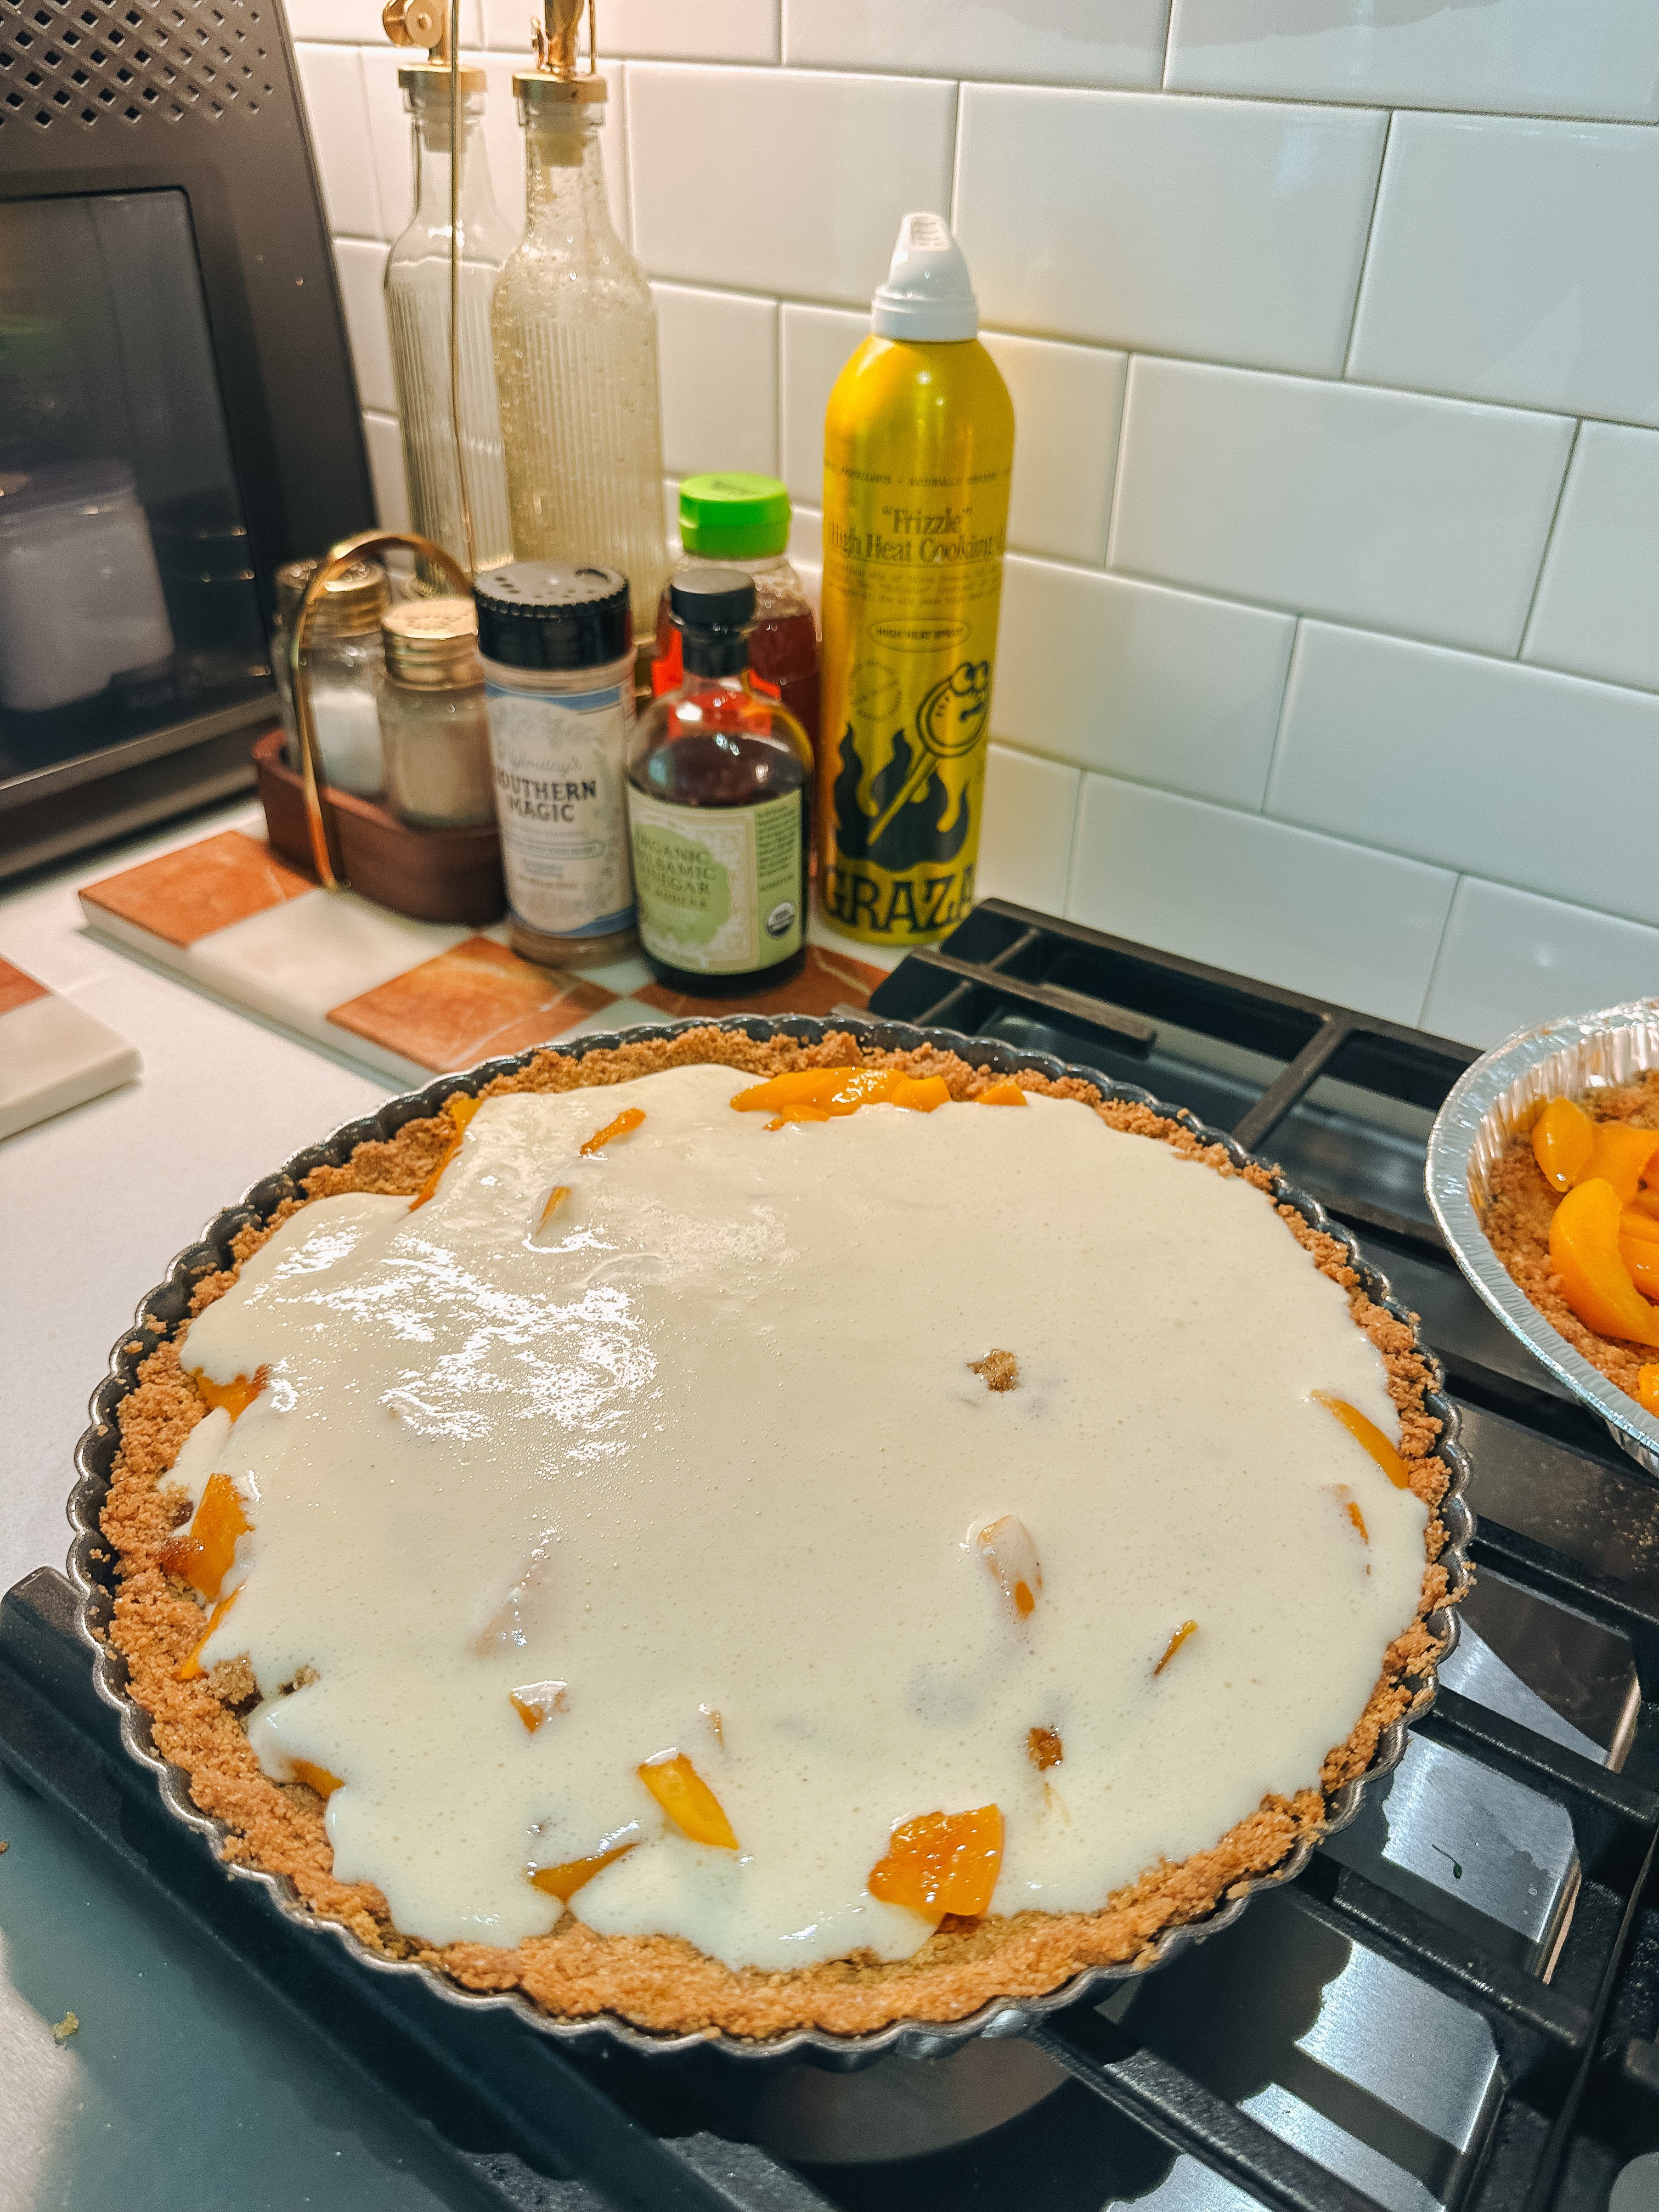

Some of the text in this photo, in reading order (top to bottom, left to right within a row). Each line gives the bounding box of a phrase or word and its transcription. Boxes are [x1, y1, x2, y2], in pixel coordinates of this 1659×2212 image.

[866, 533, 912, 563] Heat
[918, 531, 994, 565] Cooking
[496, 769, 597, 802] OUTHERN
[506, 795, 576, 823] MAGIC
